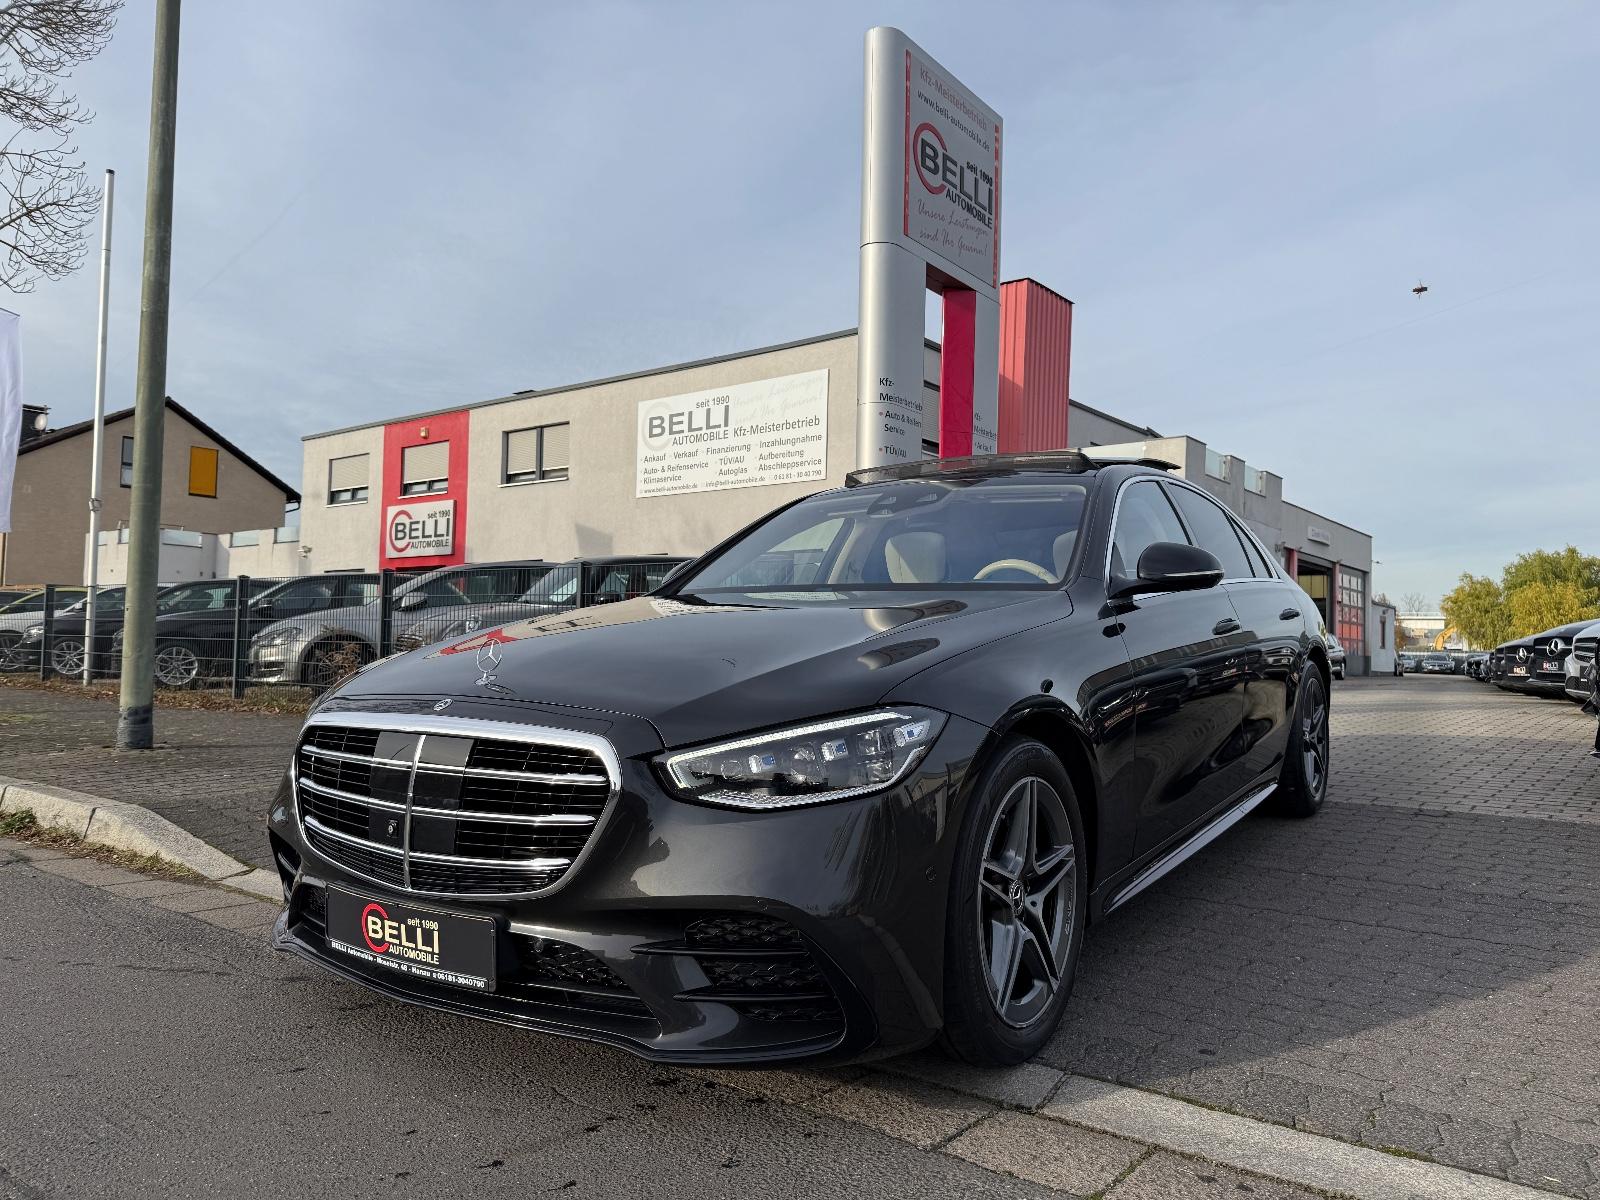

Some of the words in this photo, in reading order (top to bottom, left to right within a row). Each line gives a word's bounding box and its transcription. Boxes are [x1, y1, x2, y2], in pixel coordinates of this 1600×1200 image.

[919, 65, 988, 131] Kfz-Meisterbetrieb
[917, 89, 990, 152] www.belli-automobile.de
[920, 138, 994, 216] BELLI
[966, 159, 978, 177] seit
[979, 167, 993, 187] 1990
[945, 189, 993, 230] AUTOMOBILE
[879, 377, 895, 387] Kfz-
[695, 399, 710, 409] seit
[712, 395, 730, 406] 1990
[879, 392, 923, 411] Meisterbetrieb
[648, 405, 730, 438] BELLI
[884, 410, 900, 421] Auto
[733, 416, 821, 438] Kfz-Meisterbetrieb
[884, 423, 905, 437] Service
[672, 429, 729, 447] AUTOMOBILE
[643, 453, 667, 463] Ankauf
[673, 449, 699, 460] Verkauf
[706, 443, 751, 456] Finanzierung
[759, 434, 822, 448] Inzahlungnahme
[758, 450, 804, 462] Aufbereitung
[667, 461, 709, 473] Reifenservice
[718, 467, 748, 477] Autoglas
[758, 458, 822, 472] Abschleppservice
[643, 474, 682, 485] Klimaservice
[427, 511, 438, 519] seit
[438, 509, 451, 518] 1990
[394, 518, 450, 541] BELLI
[411, 539, 449, 549] AUTOMOBILE
[407, 917, 420, 927] seit
[421, 920, 439, 931] 1990
[367, 916, 440, 953] BELLI
[388, 944, 440, 965] AUTOMOBILE
[331, 941, 347, 953] BELLI
[437, 973, 485, 988] 06181-3040790
